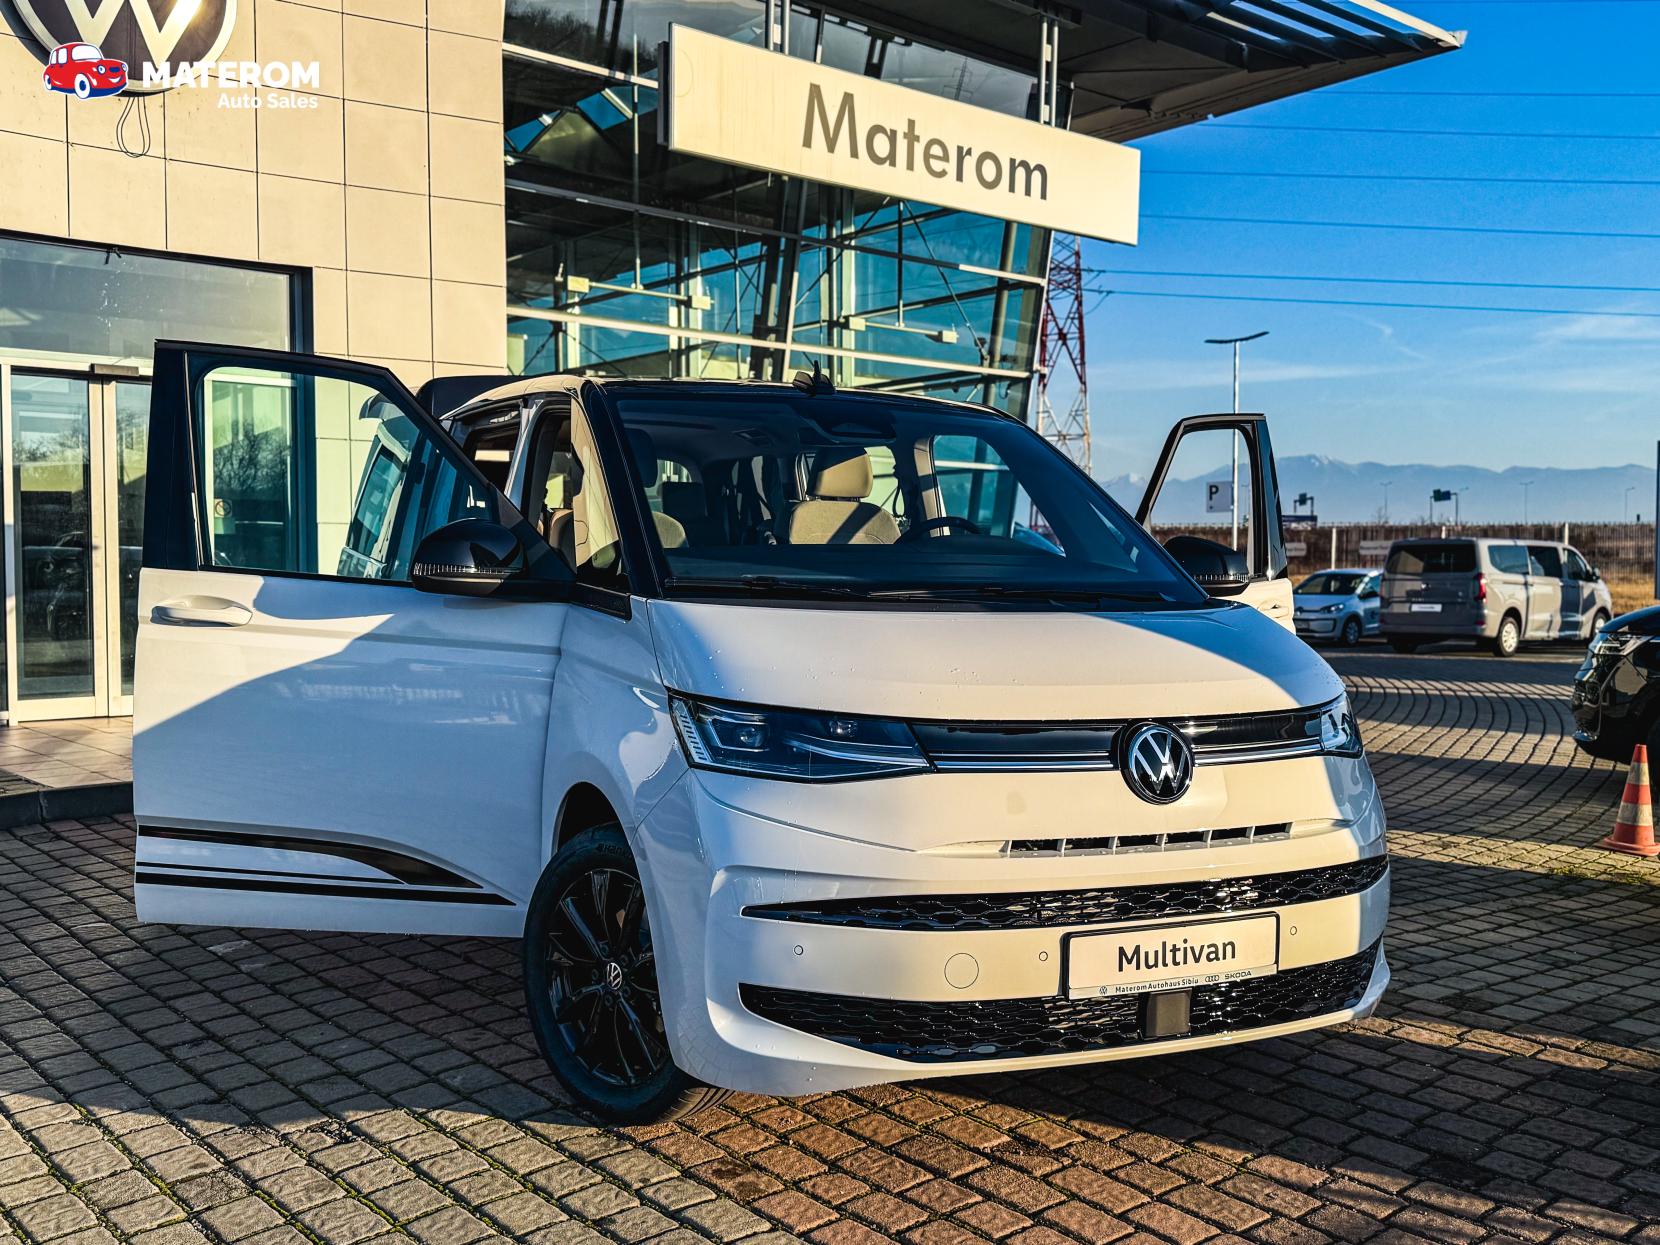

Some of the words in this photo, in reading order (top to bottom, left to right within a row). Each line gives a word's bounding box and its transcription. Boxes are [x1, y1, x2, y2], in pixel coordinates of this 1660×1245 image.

[802, 82, 1048, 200] Materom
[1209, 484, 1219, 501] P
[1118, 938, 1236, 972] Multivan
[1115, 983, 1147, 993] Materom
[1148, 980, 1180, 990] Autohaus
[1182, 977, 1199, 986] Sibiu
